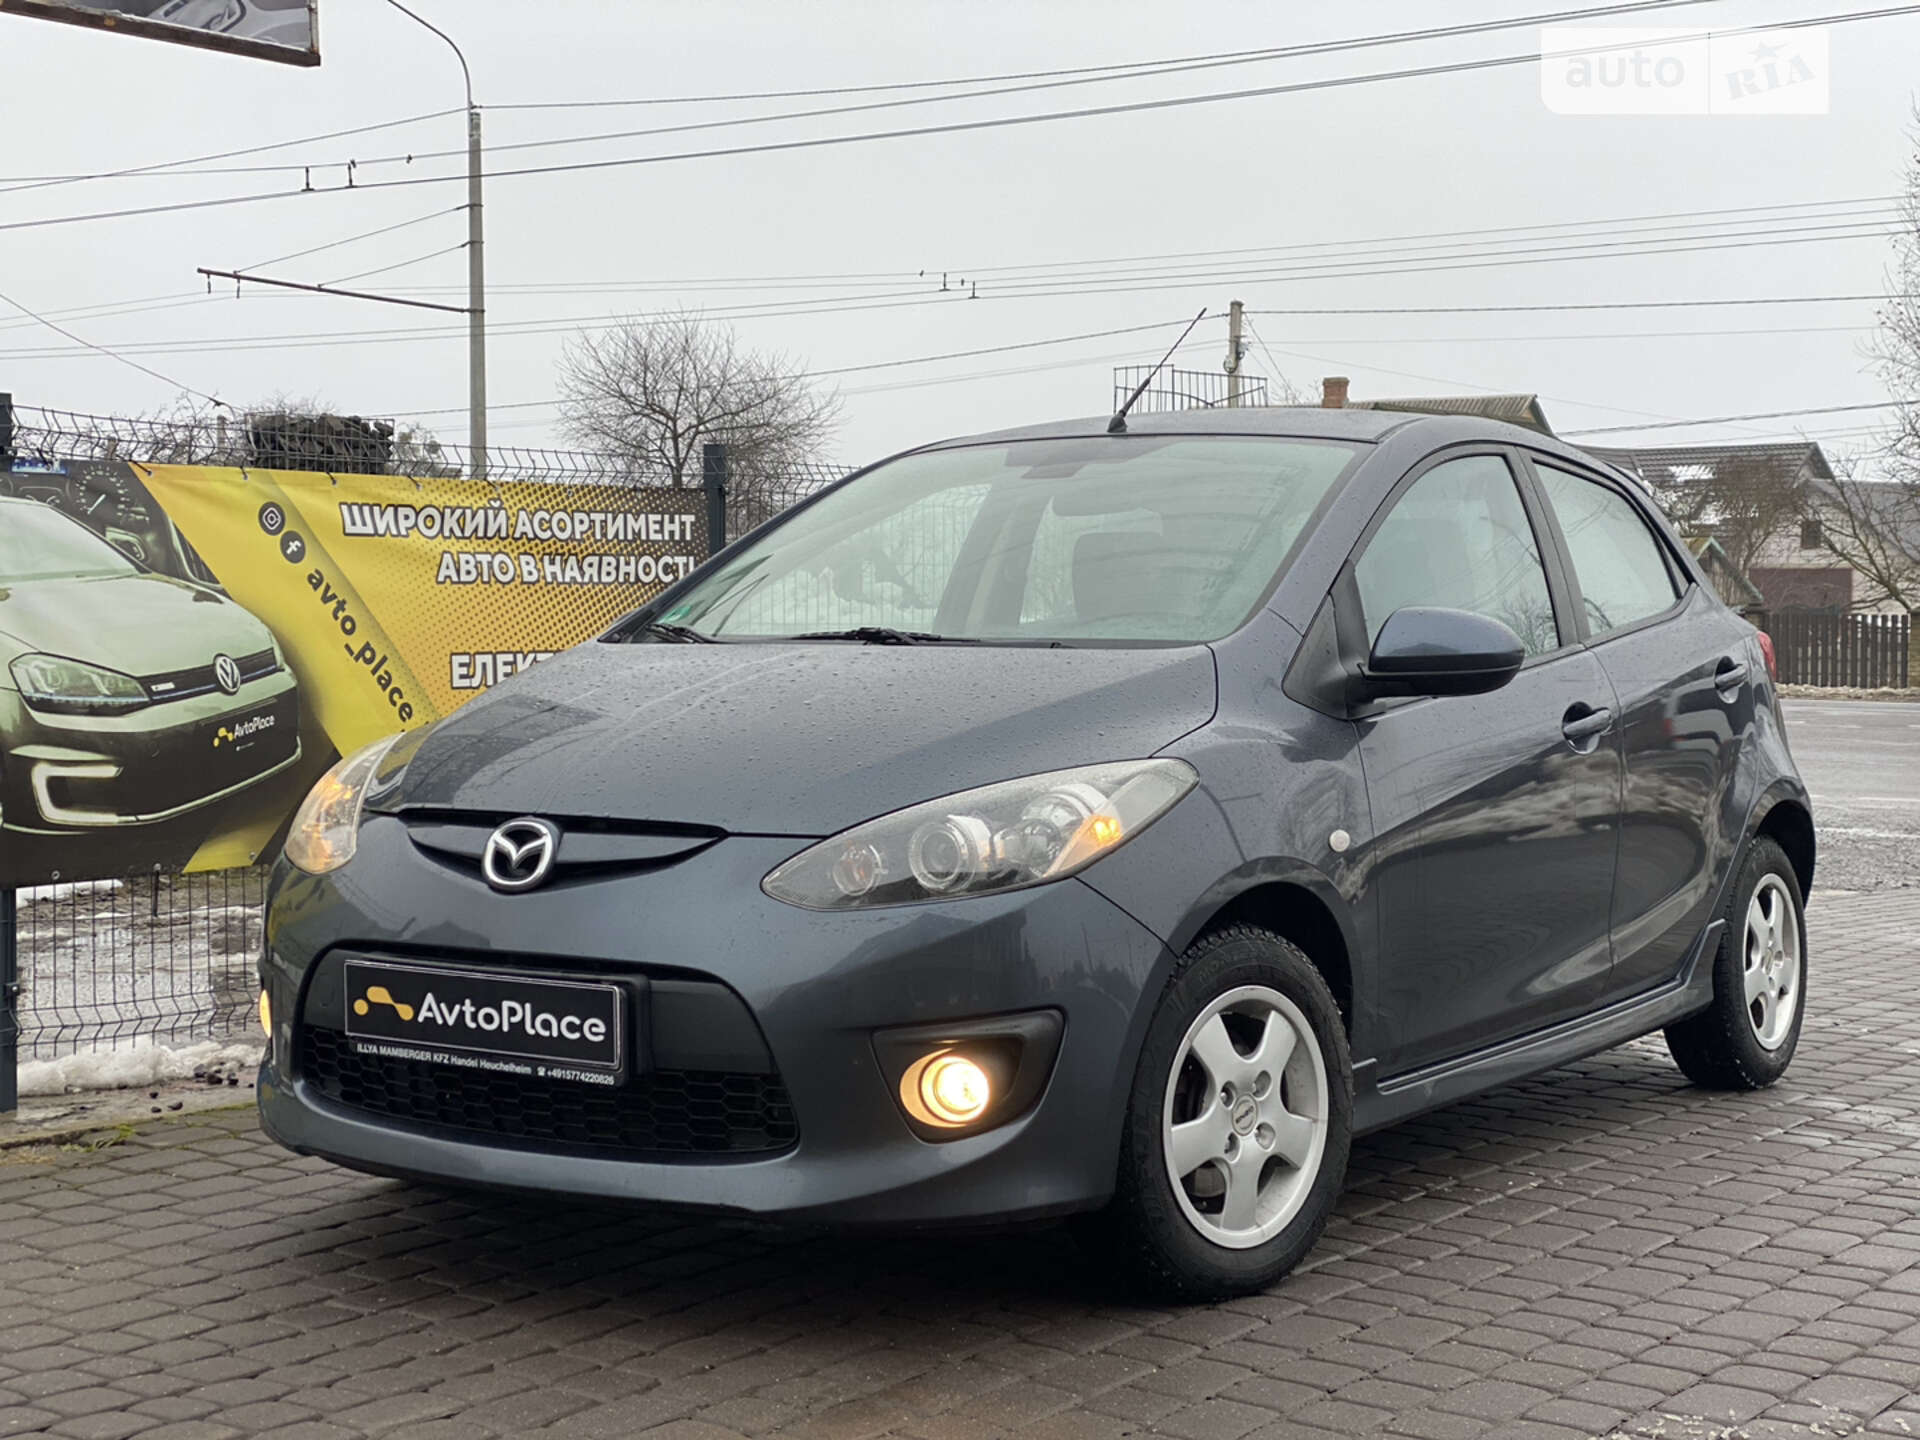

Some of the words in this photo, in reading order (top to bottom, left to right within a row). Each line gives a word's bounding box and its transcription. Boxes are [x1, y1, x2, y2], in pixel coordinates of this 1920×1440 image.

[341, 499, 509, 539] ШИРОКИЙ
[512, 511, 696, 541] АСОРТИМЕНТ
[437, 552, 515, 583] АВТО
[519, 554, 539, 583] В
[306, 567, 429, 733] avto_place
[233, 714, 275, 738] AvtoPlace
[417, 991, 607, 1042] AvtoPlace
[432, 1052, 450, 1065] KFZ
[450, 1054, 479, 1069] Handel
